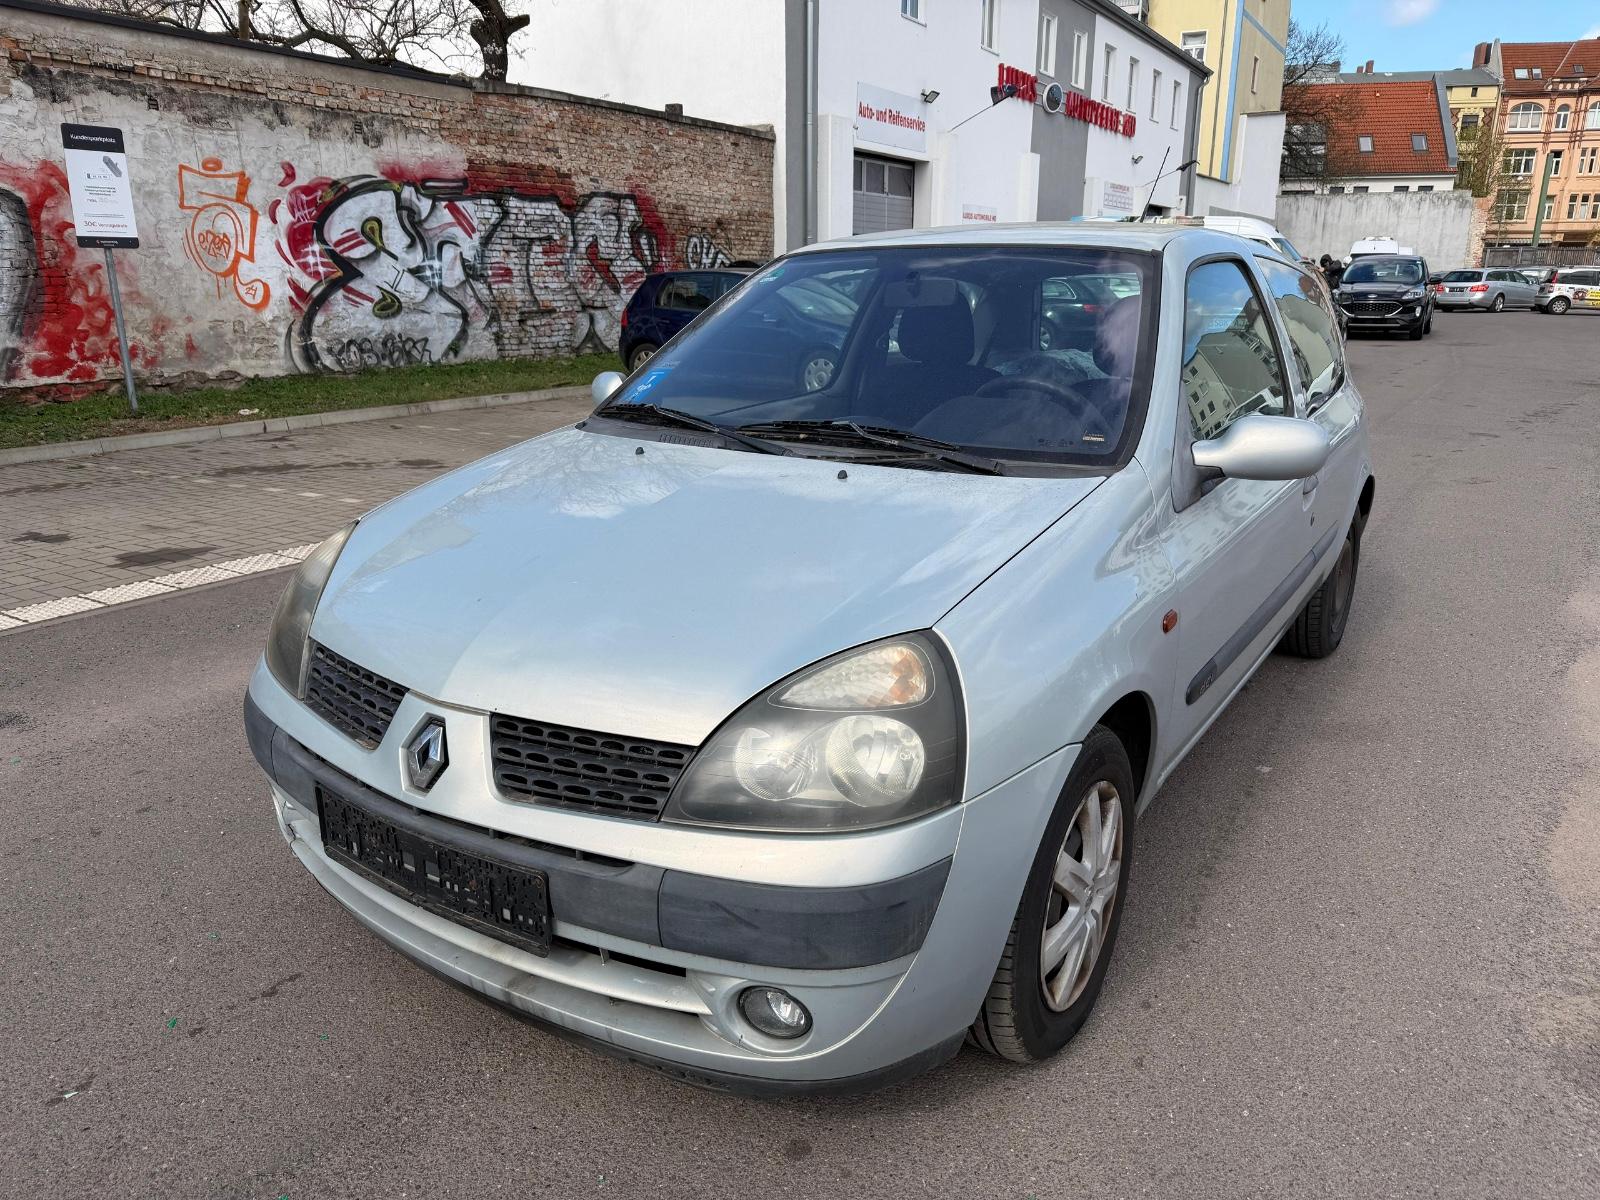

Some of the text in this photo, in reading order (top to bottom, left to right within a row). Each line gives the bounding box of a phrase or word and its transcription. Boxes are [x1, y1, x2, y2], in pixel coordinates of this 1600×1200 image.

[859, 101, 926, 132] Auto- und Reifenservice
[70, 133, 116, 143] Kundenparkplatz
